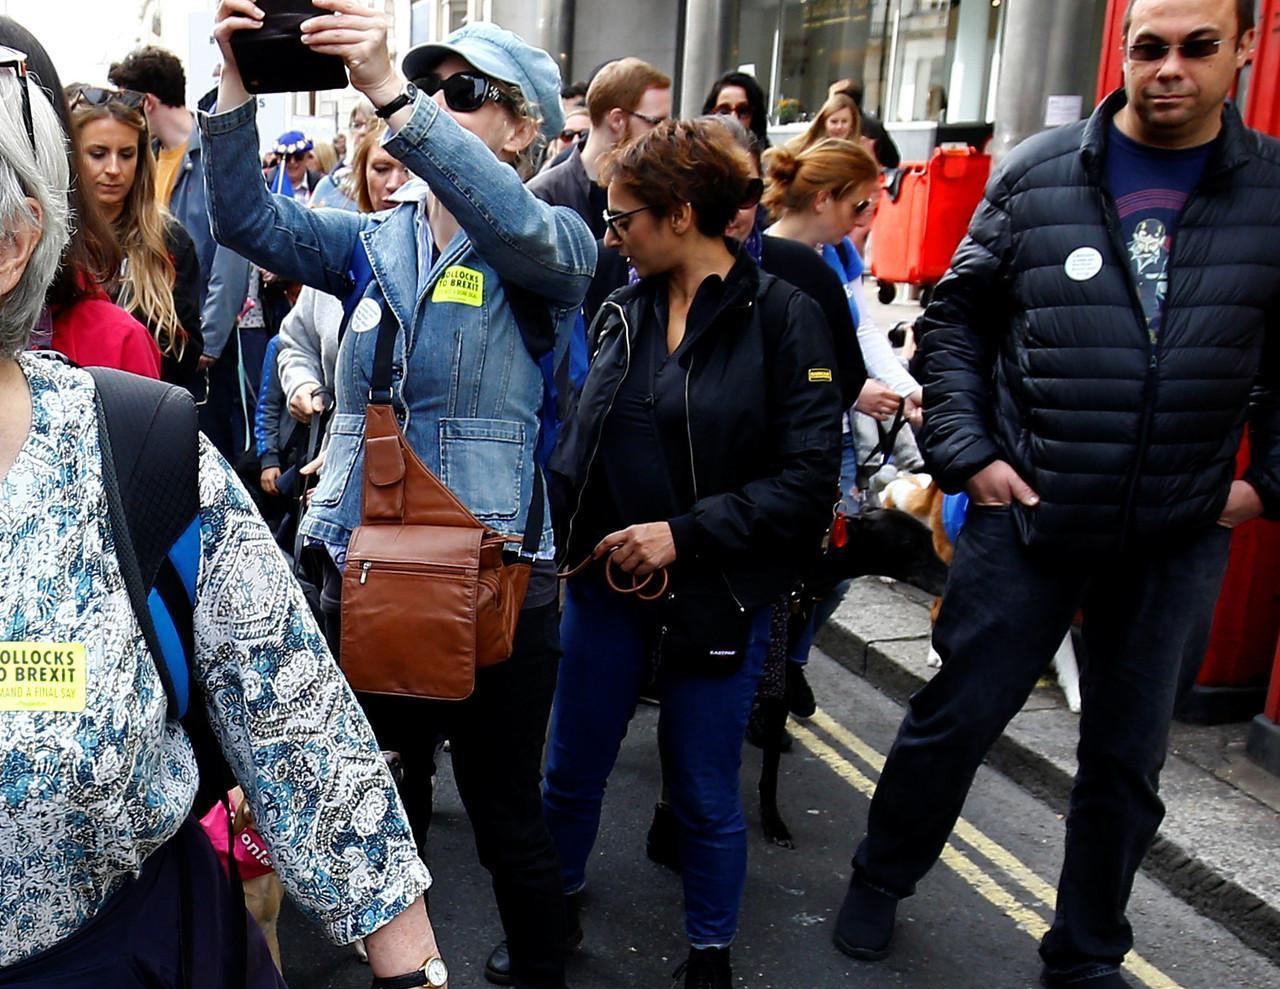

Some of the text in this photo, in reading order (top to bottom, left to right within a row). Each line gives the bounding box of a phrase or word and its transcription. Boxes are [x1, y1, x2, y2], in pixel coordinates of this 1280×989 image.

[442, 270, 479, 283] OLLOCKS
[450, 280, 479, 291] BREXIT
[15, 667, 76, 683] BREXIT
